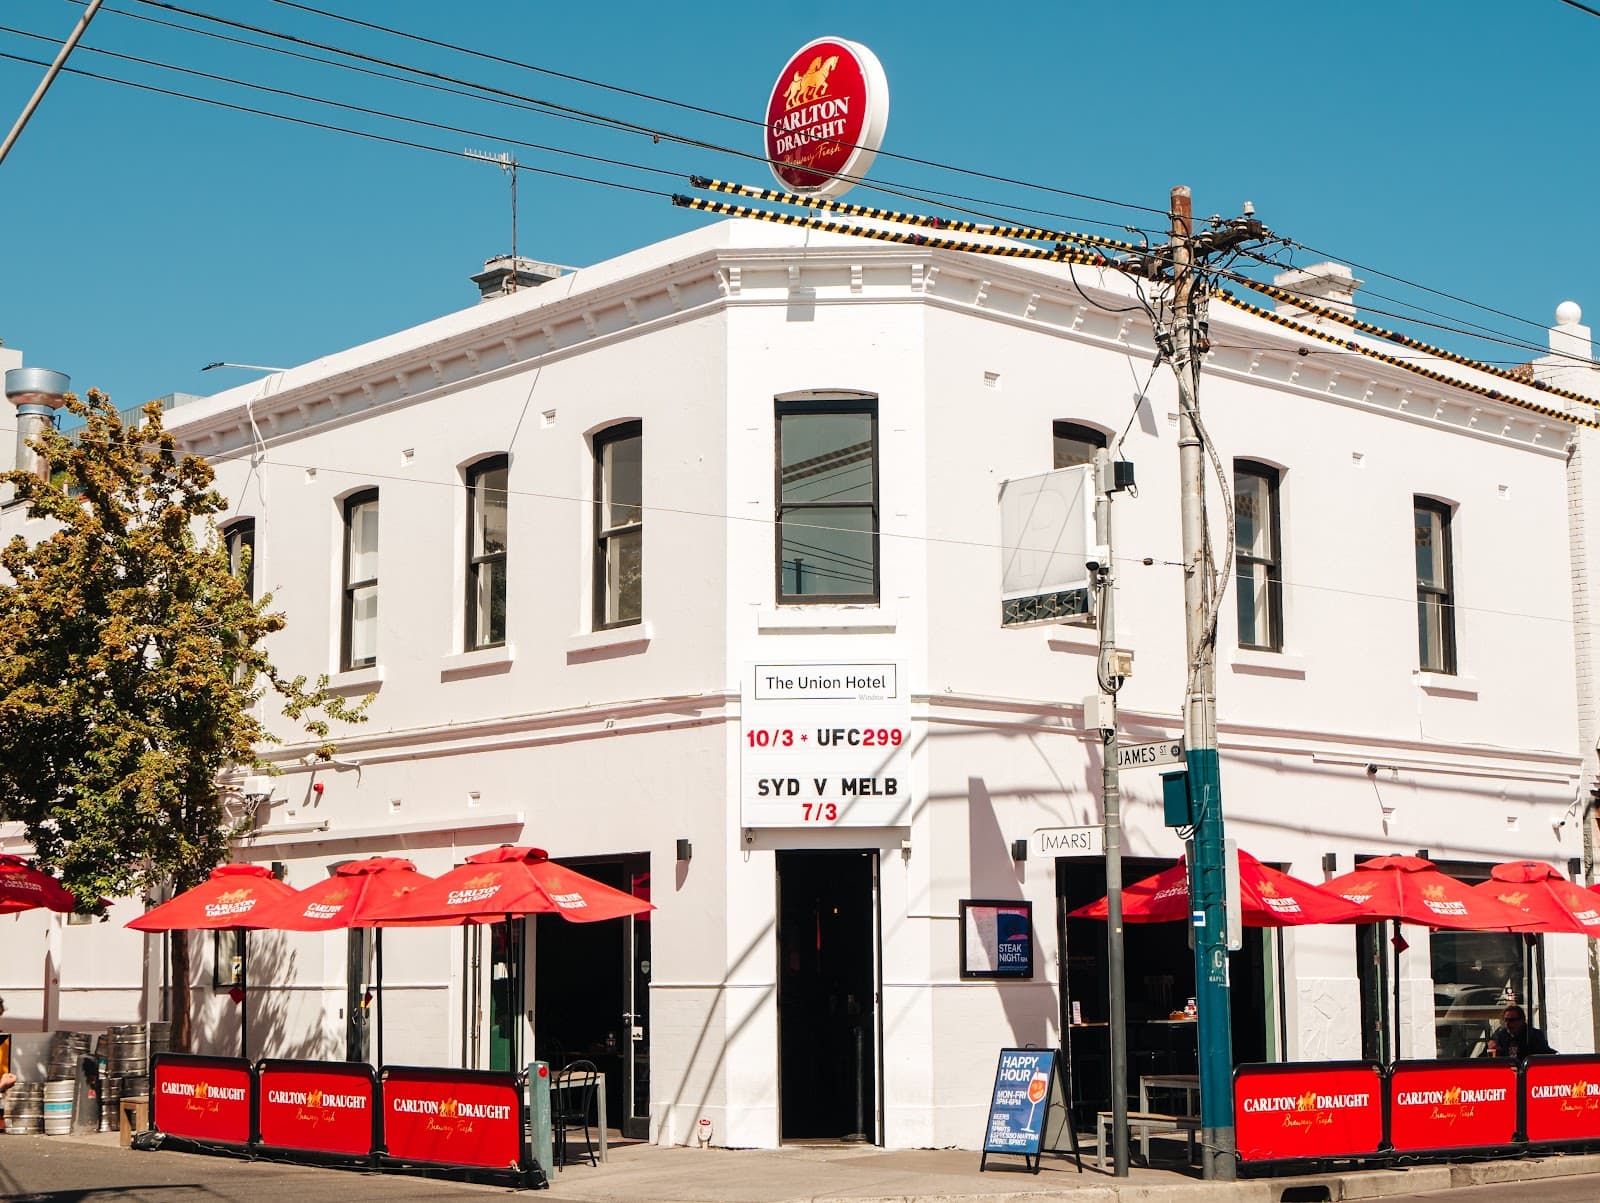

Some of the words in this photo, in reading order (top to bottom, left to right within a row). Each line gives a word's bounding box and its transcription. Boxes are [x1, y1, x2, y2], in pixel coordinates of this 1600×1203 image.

[773, 97, 850, 137] CARLTON
[776, 118, 846, 155] DRAUGHT
[816, 142, 841, 157] Fresh
[766, 677, 793, 689] The
[798, 676, 841, 689] Union
[846, 676, 886, 689] Hotel
[747, 729, 794, 747] 10/3
[817, 728, 902, 746] UFC299
[1118, 748, 1156, 765] JAMES
[758, 778, 800, 796] SYD
[814, 778, 827, 796] V
[842, 778, 898, 796] MELB
[802, 804, 838, 821] 7/3
[1041, 831, 1091, 852] [MARS]
[205, 898, 256, 911] CARLTON
[998, 944, 1022, 953] STEAK
[1000, 954, 1021, 962] NIGHT
[1002, 1056, 1039, 1068] HAPPY
[1000, 1069, 1031, 1082] HOUR
[162, 1082, 195, 1096] CARLTON
[208, 1086, 246, 1100] DRAUGHT
[268, 1090, 306, 1104] CARLTON
[322, 1094, 366, 1108] DRAUGHT
[997, 1090, 1026, 1099] MON-FRI
[1398, 1090, 1444, 1105] CARLTON
[1461, 1088, 1506, 1102] DRAUGHT
[1532, 1084, 1571, 1098] CARLTON
[394, 1098, 438, 1114] CARLTON
[458, 1103, 510, 1120] DRAUGHT
[1244, 1097, 1296, 1112] CARLTON
[1316, 1094, 1369, 1109] DRAUGHT
